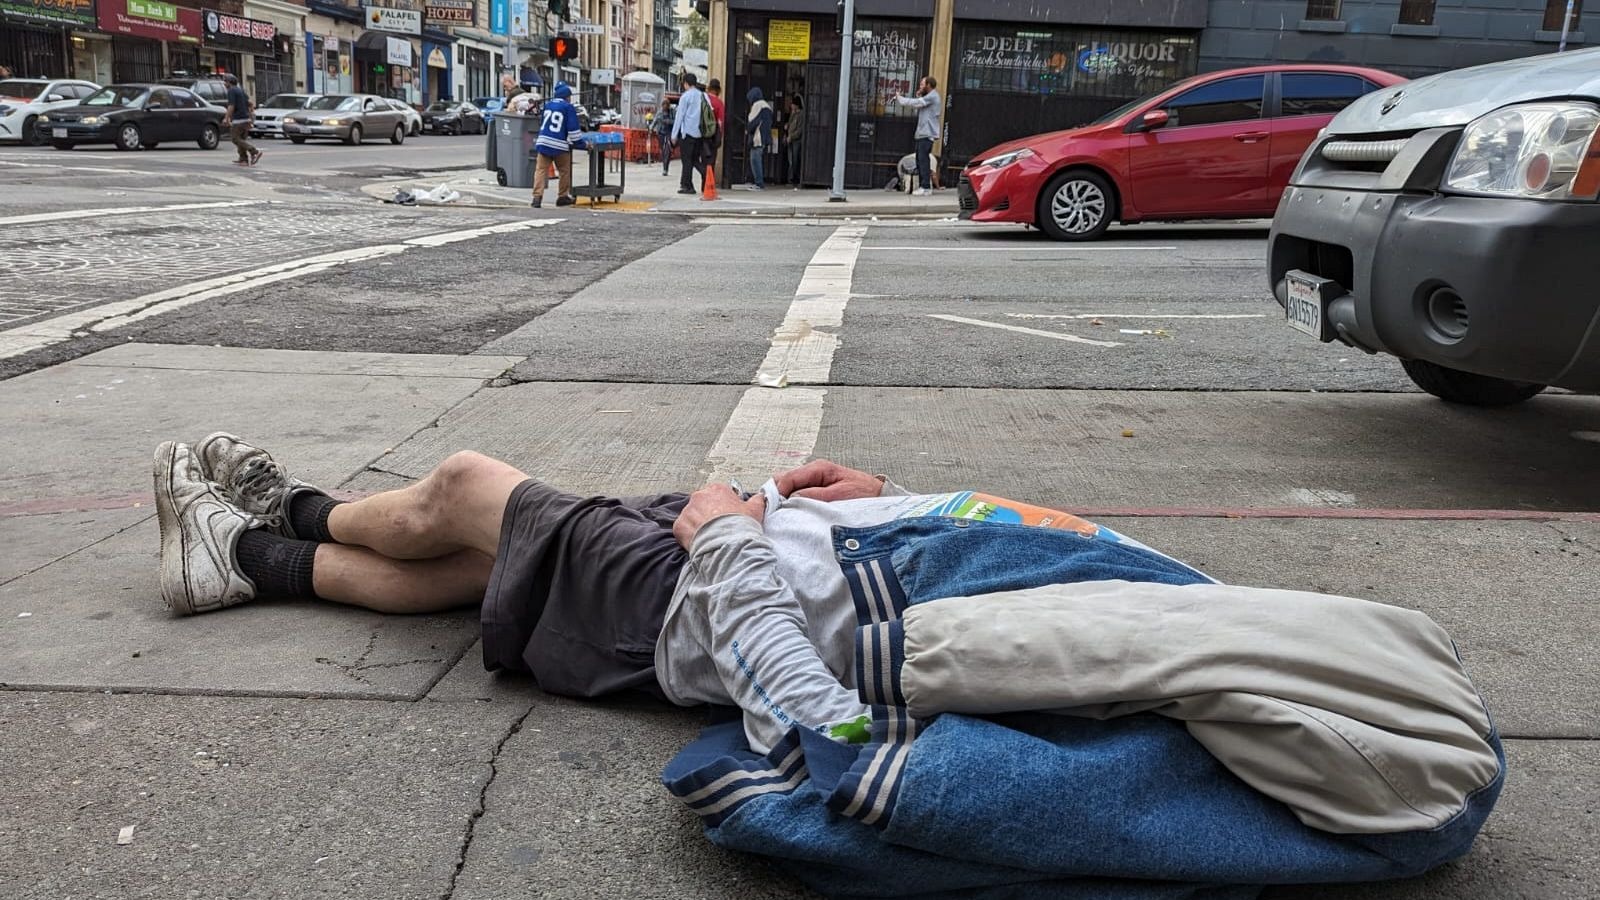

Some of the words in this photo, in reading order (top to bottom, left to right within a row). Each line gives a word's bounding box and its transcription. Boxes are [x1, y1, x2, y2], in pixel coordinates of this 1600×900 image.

[380, 9, 417, 20] FALAFEL
[427, 7, 472, 20] HOTEL
[220, 15, 251, 38] SMOKE
[251, 21, 274, 41] SHOP
[962, 49, 993, 65] Fresh
[1091, 41, 1176, 63] LIQUOR
[541, 110, 564, 133] 79
